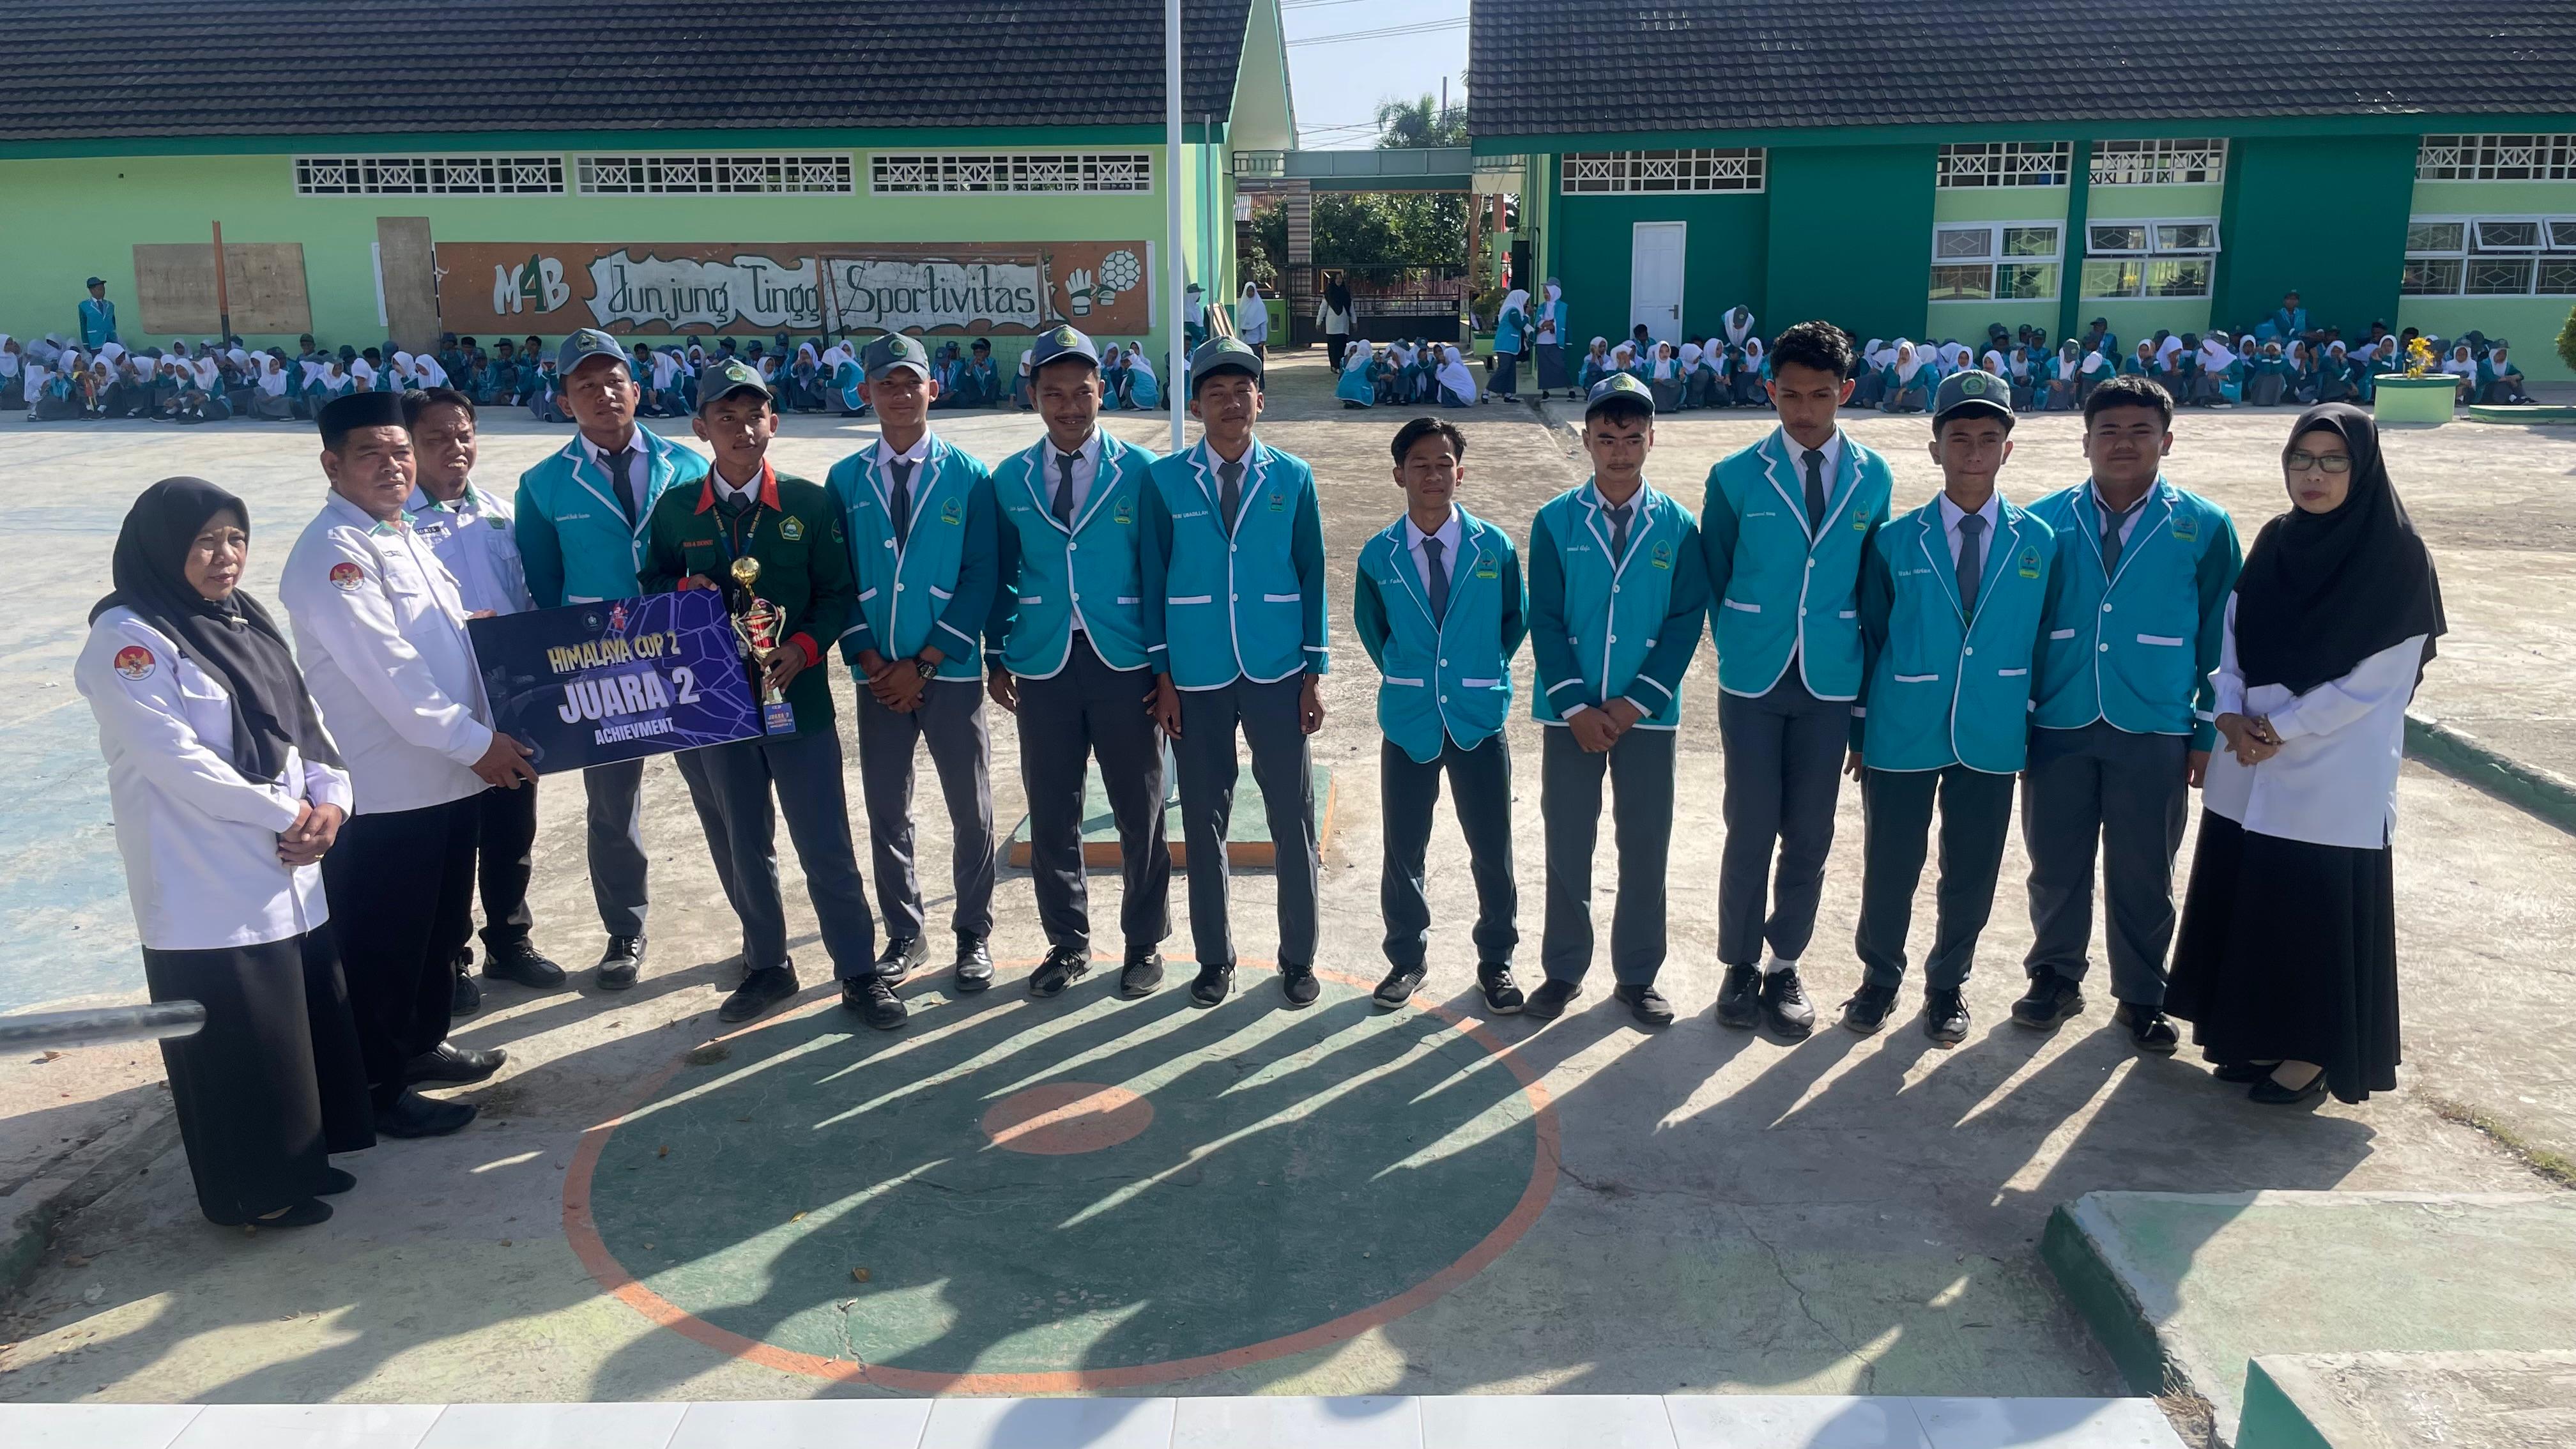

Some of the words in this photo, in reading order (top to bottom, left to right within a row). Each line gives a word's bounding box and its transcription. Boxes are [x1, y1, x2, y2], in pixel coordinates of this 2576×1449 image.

[608, 264, 728, 323] Junjung
[740, 264, 820, 321] Tingg
[840, 261, 1035, 323] Sportivitas
[547, 639, 633, 674] HIMALAYA
[634, 633, 664, 659] CUP
[667, 629, 682, 655] 2
[558, 670, 670, 724] JUARA
[672, 666, 701, 705] 2
[594, 717, 675, 746] ACHIEVMENT
